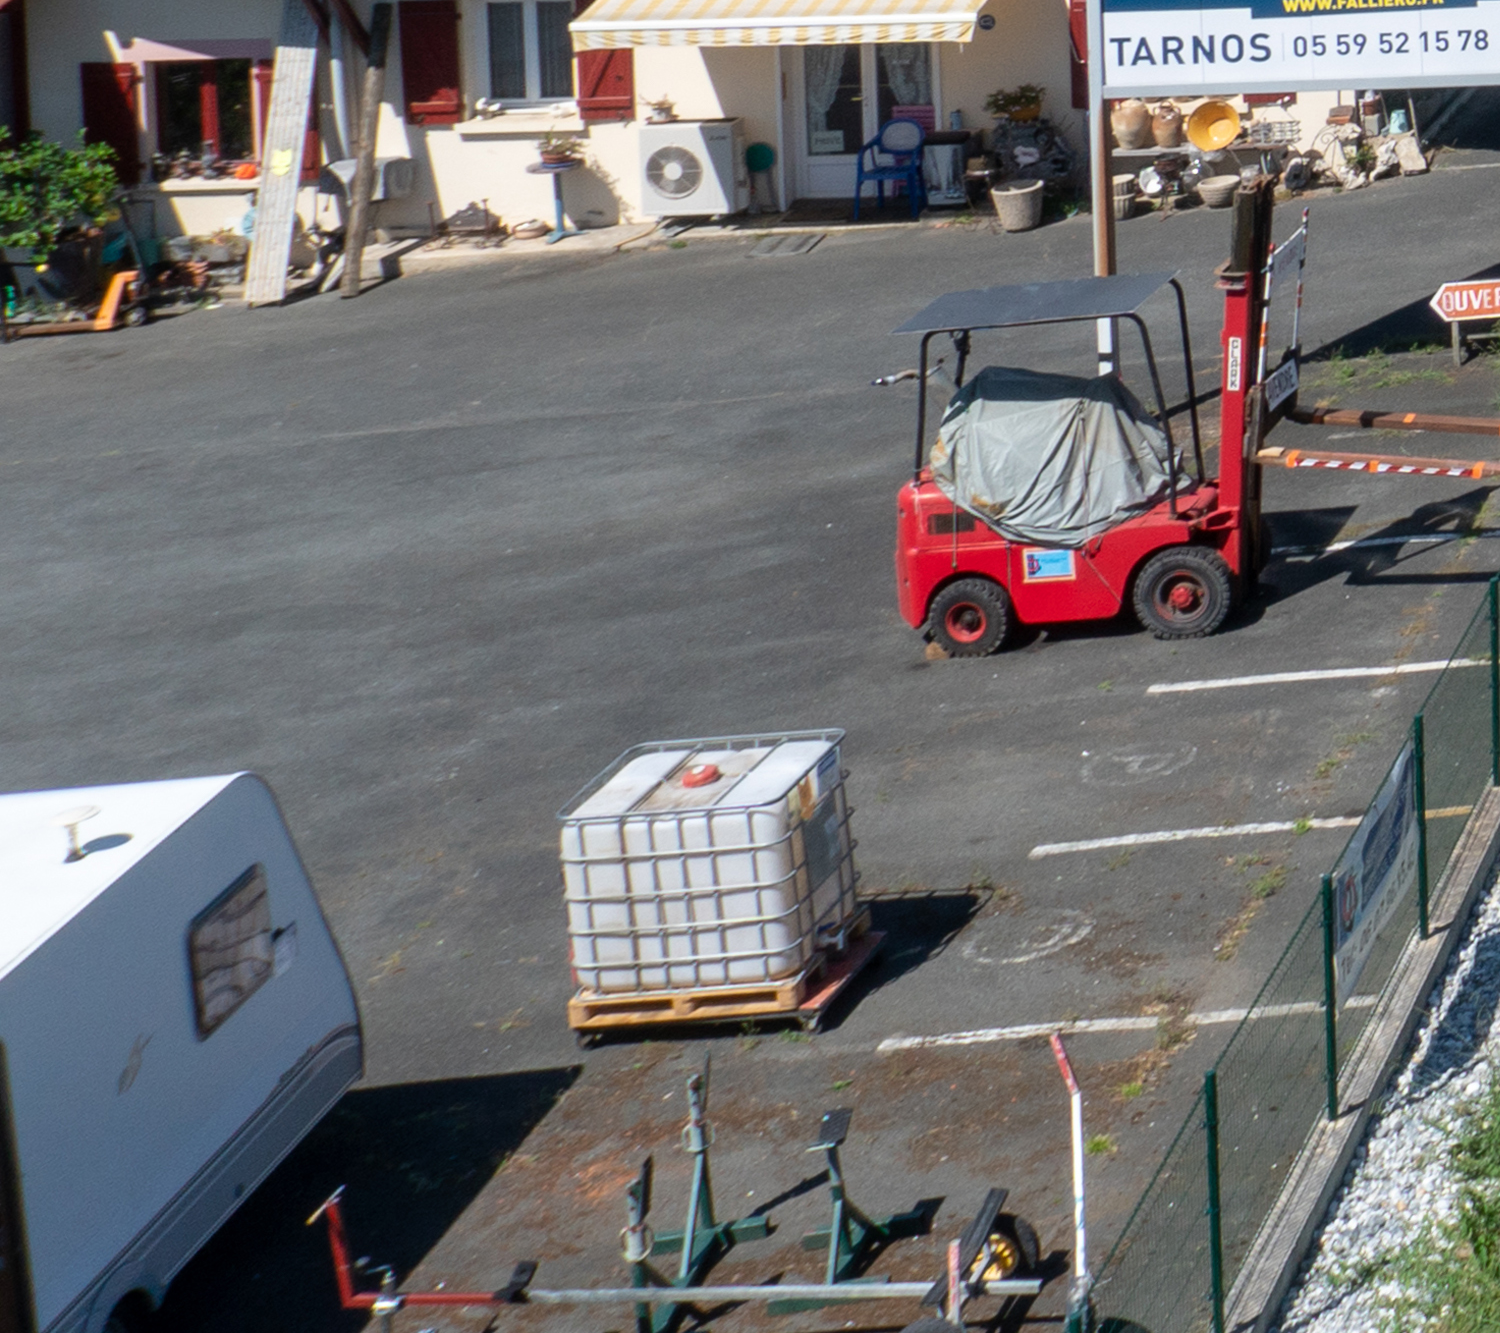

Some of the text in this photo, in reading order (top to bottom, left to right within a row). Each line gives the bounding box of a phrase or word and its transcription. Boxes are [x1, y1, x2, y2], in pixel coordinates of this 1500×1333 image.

[1110, 32, 1273, 67] TARNOS
[1293, 29, 1490, 58] 05 59 52 15 78
[1229, 339, 1239, 390] CLARK
